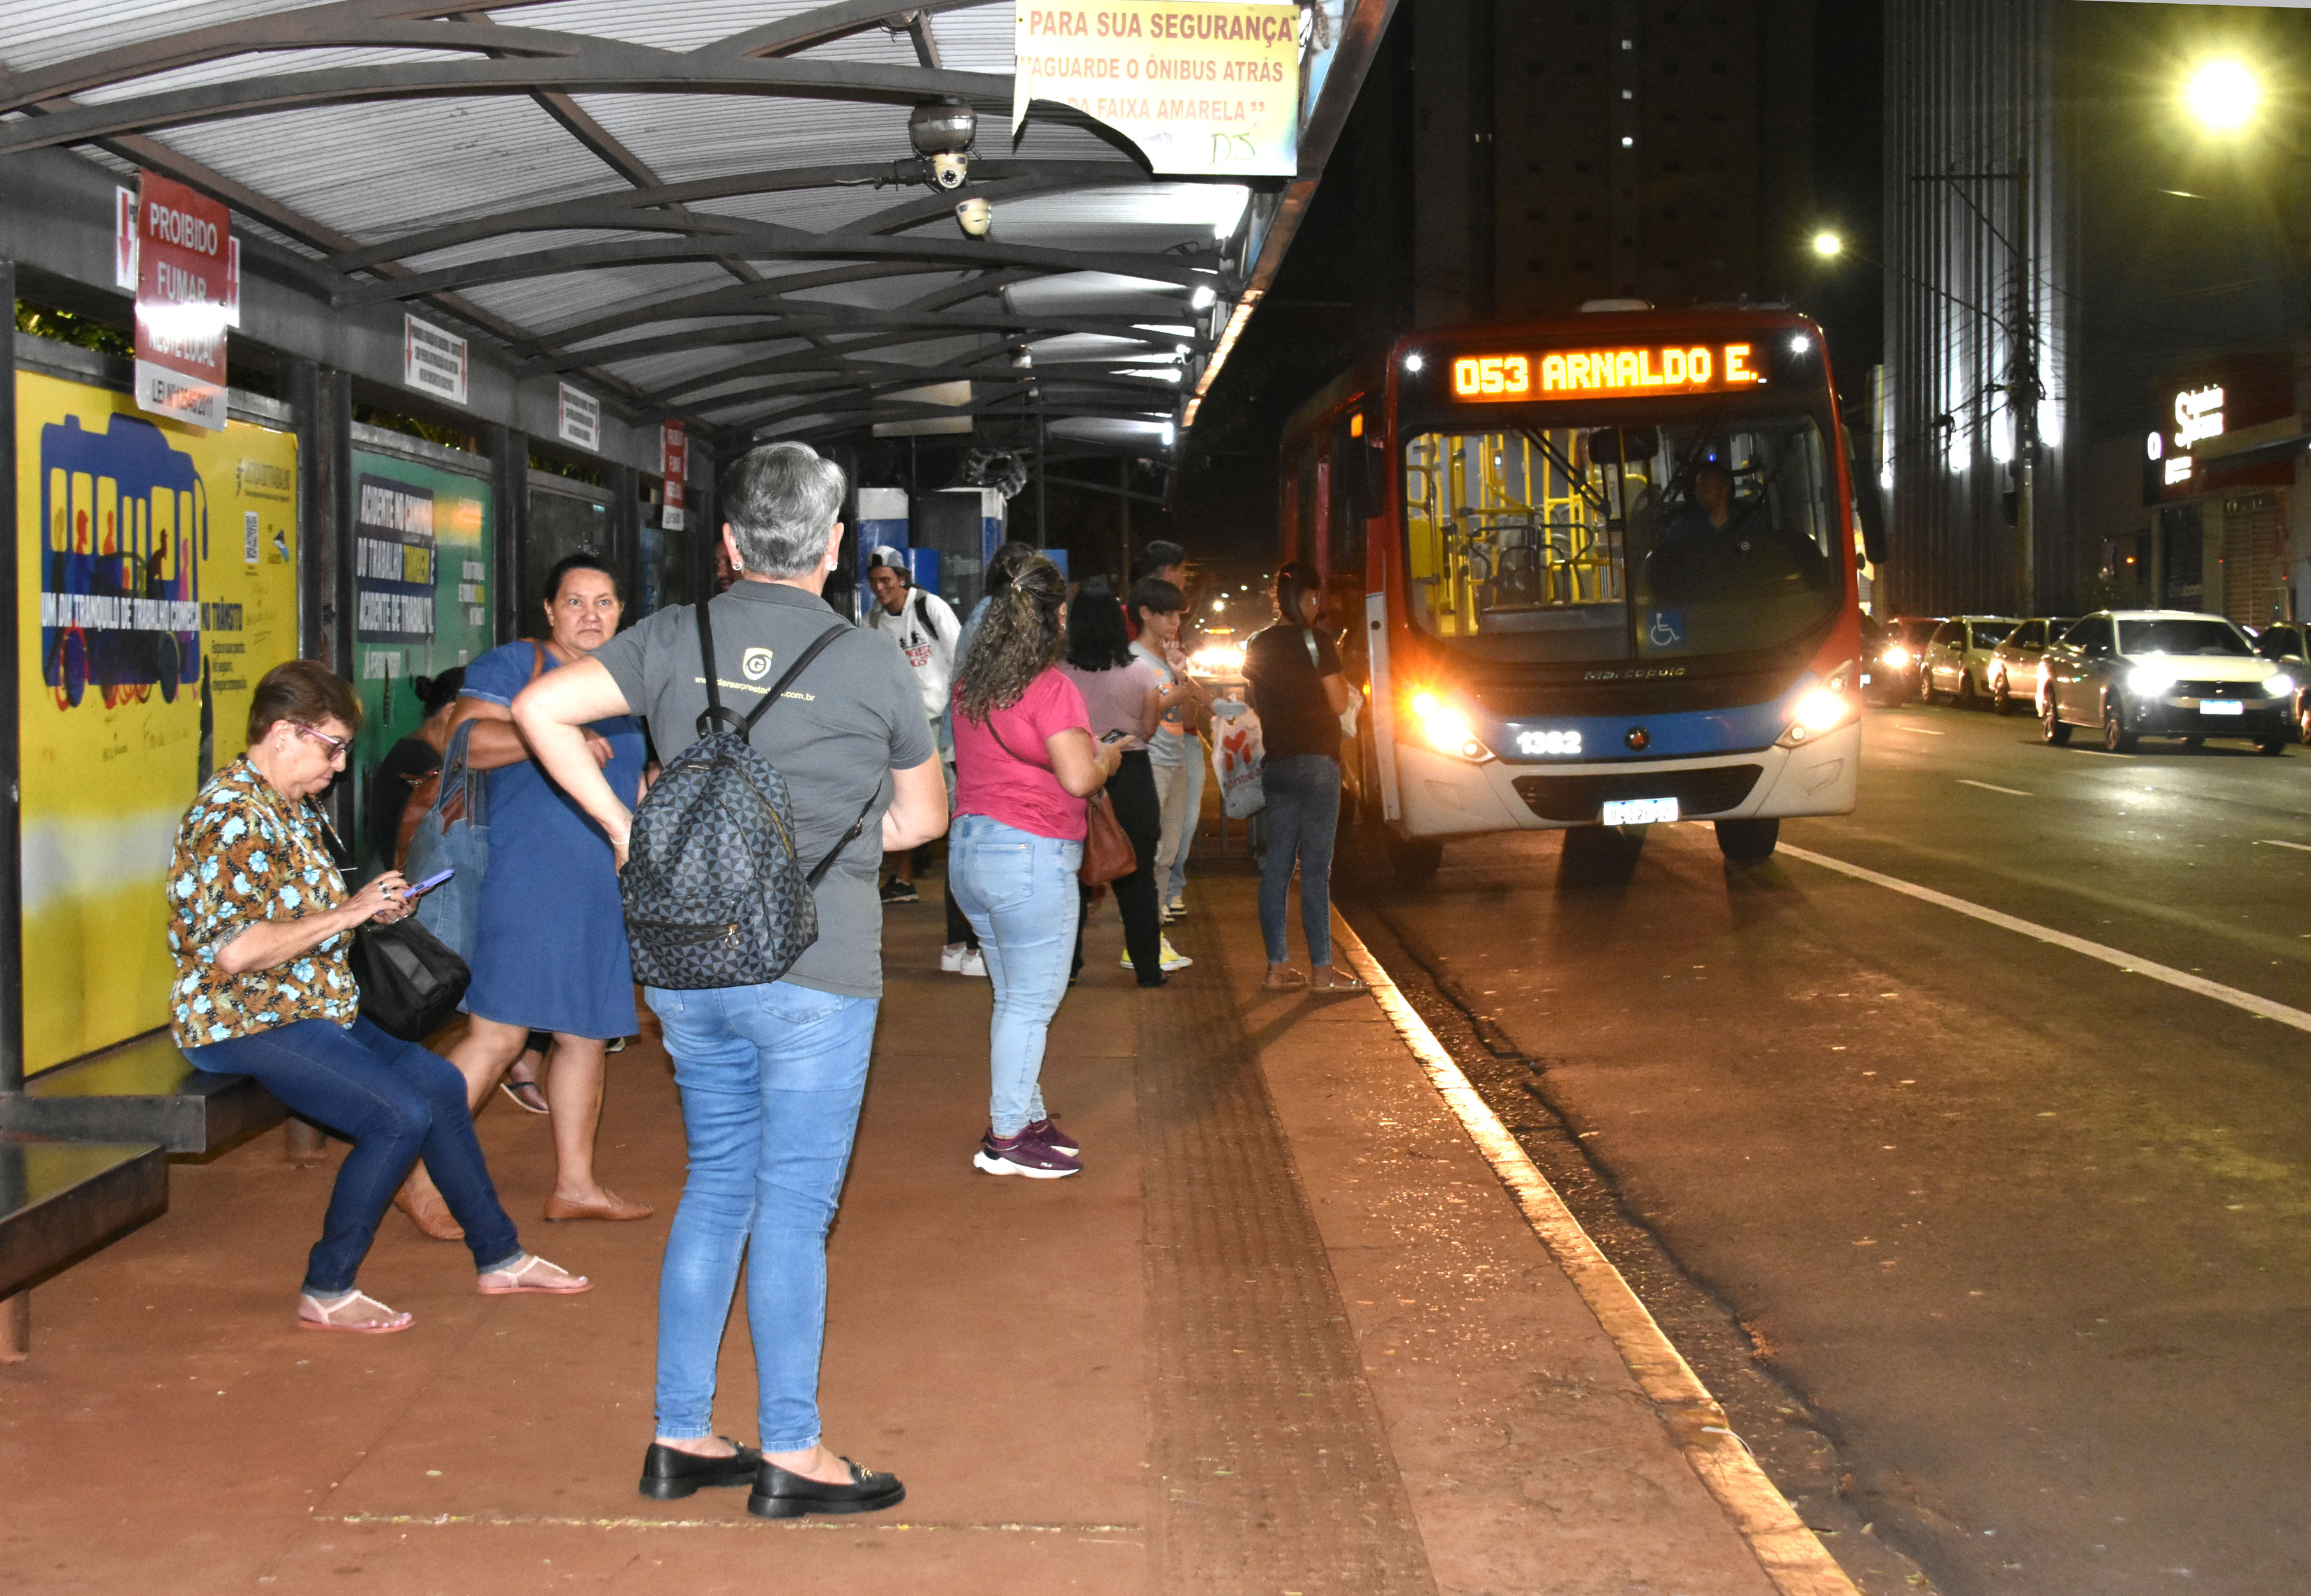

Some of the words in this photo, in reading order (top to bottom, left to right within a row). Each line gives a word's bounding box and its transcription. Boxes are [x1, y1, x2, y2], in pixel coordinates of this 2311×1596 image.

[1030, 11, 1088, 36] PARA
[1097, 12, 1142, 38] SUA
[1150, 13, 1293, 48] SEGURANÇA
[1127, 58, 1139, 80] O
[1146, 54, 1216, 81] ÔNIBUS
[1223, 57, 1284, 82] ATRÁS
[1098, 98, 1151, 120] FAIXA
[150, 202, 217, 255] PROIBIDO
[157, 261, 207, 305] FUMAR
[1455, 356, 1529, 394] 053
[1542, 347, 1712, 390] ARNALDO
[1725, 345, 1757, 382] E.
